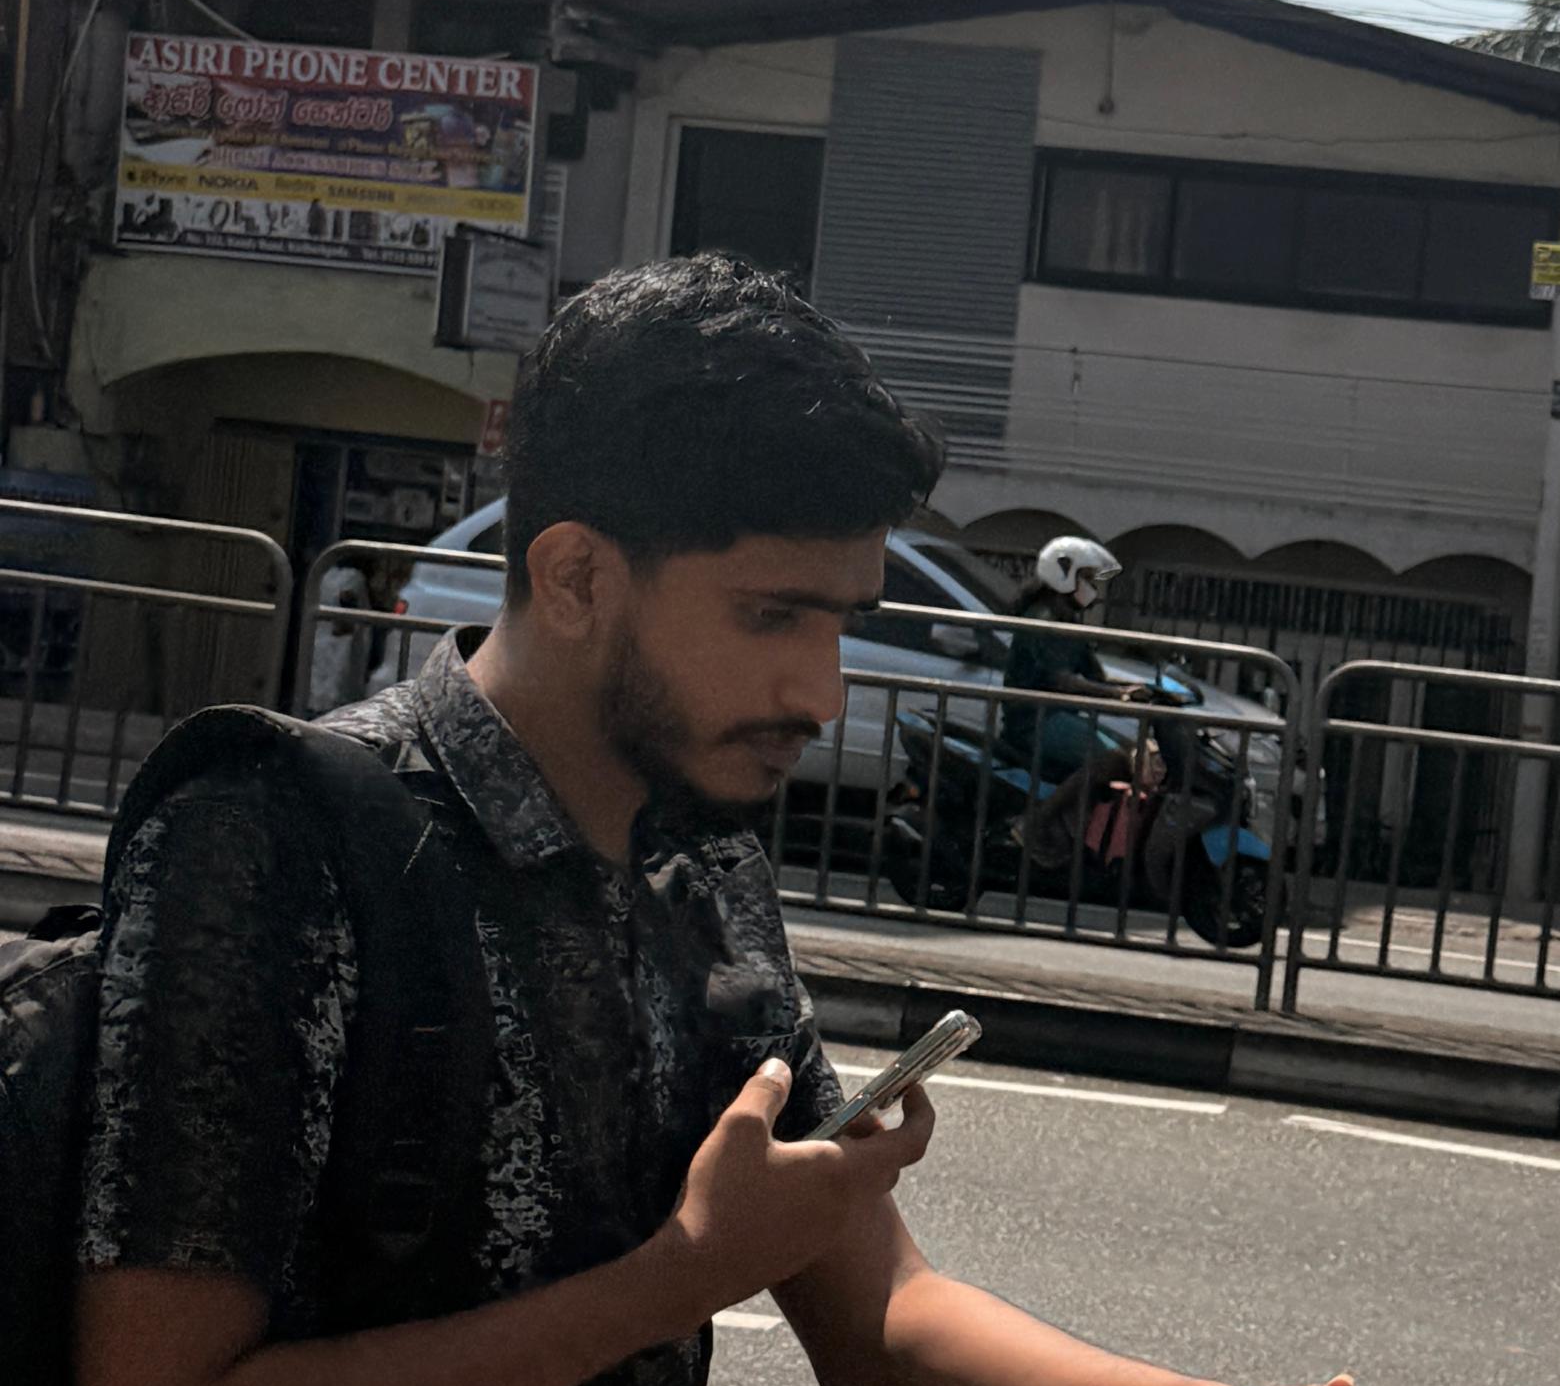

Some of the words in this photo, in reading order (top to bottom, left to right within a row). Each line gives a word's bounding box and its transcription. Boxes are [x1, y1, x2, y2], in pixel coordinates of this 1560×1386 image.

[139, 38, 233, 76] ASIRI
[243, 45, 368, 86] PHONE
[378, 57, 523, 100] CENTER
[198, 174, 259, 190] NOKIA
[327, 184, 395, 203] SAMSUNG
